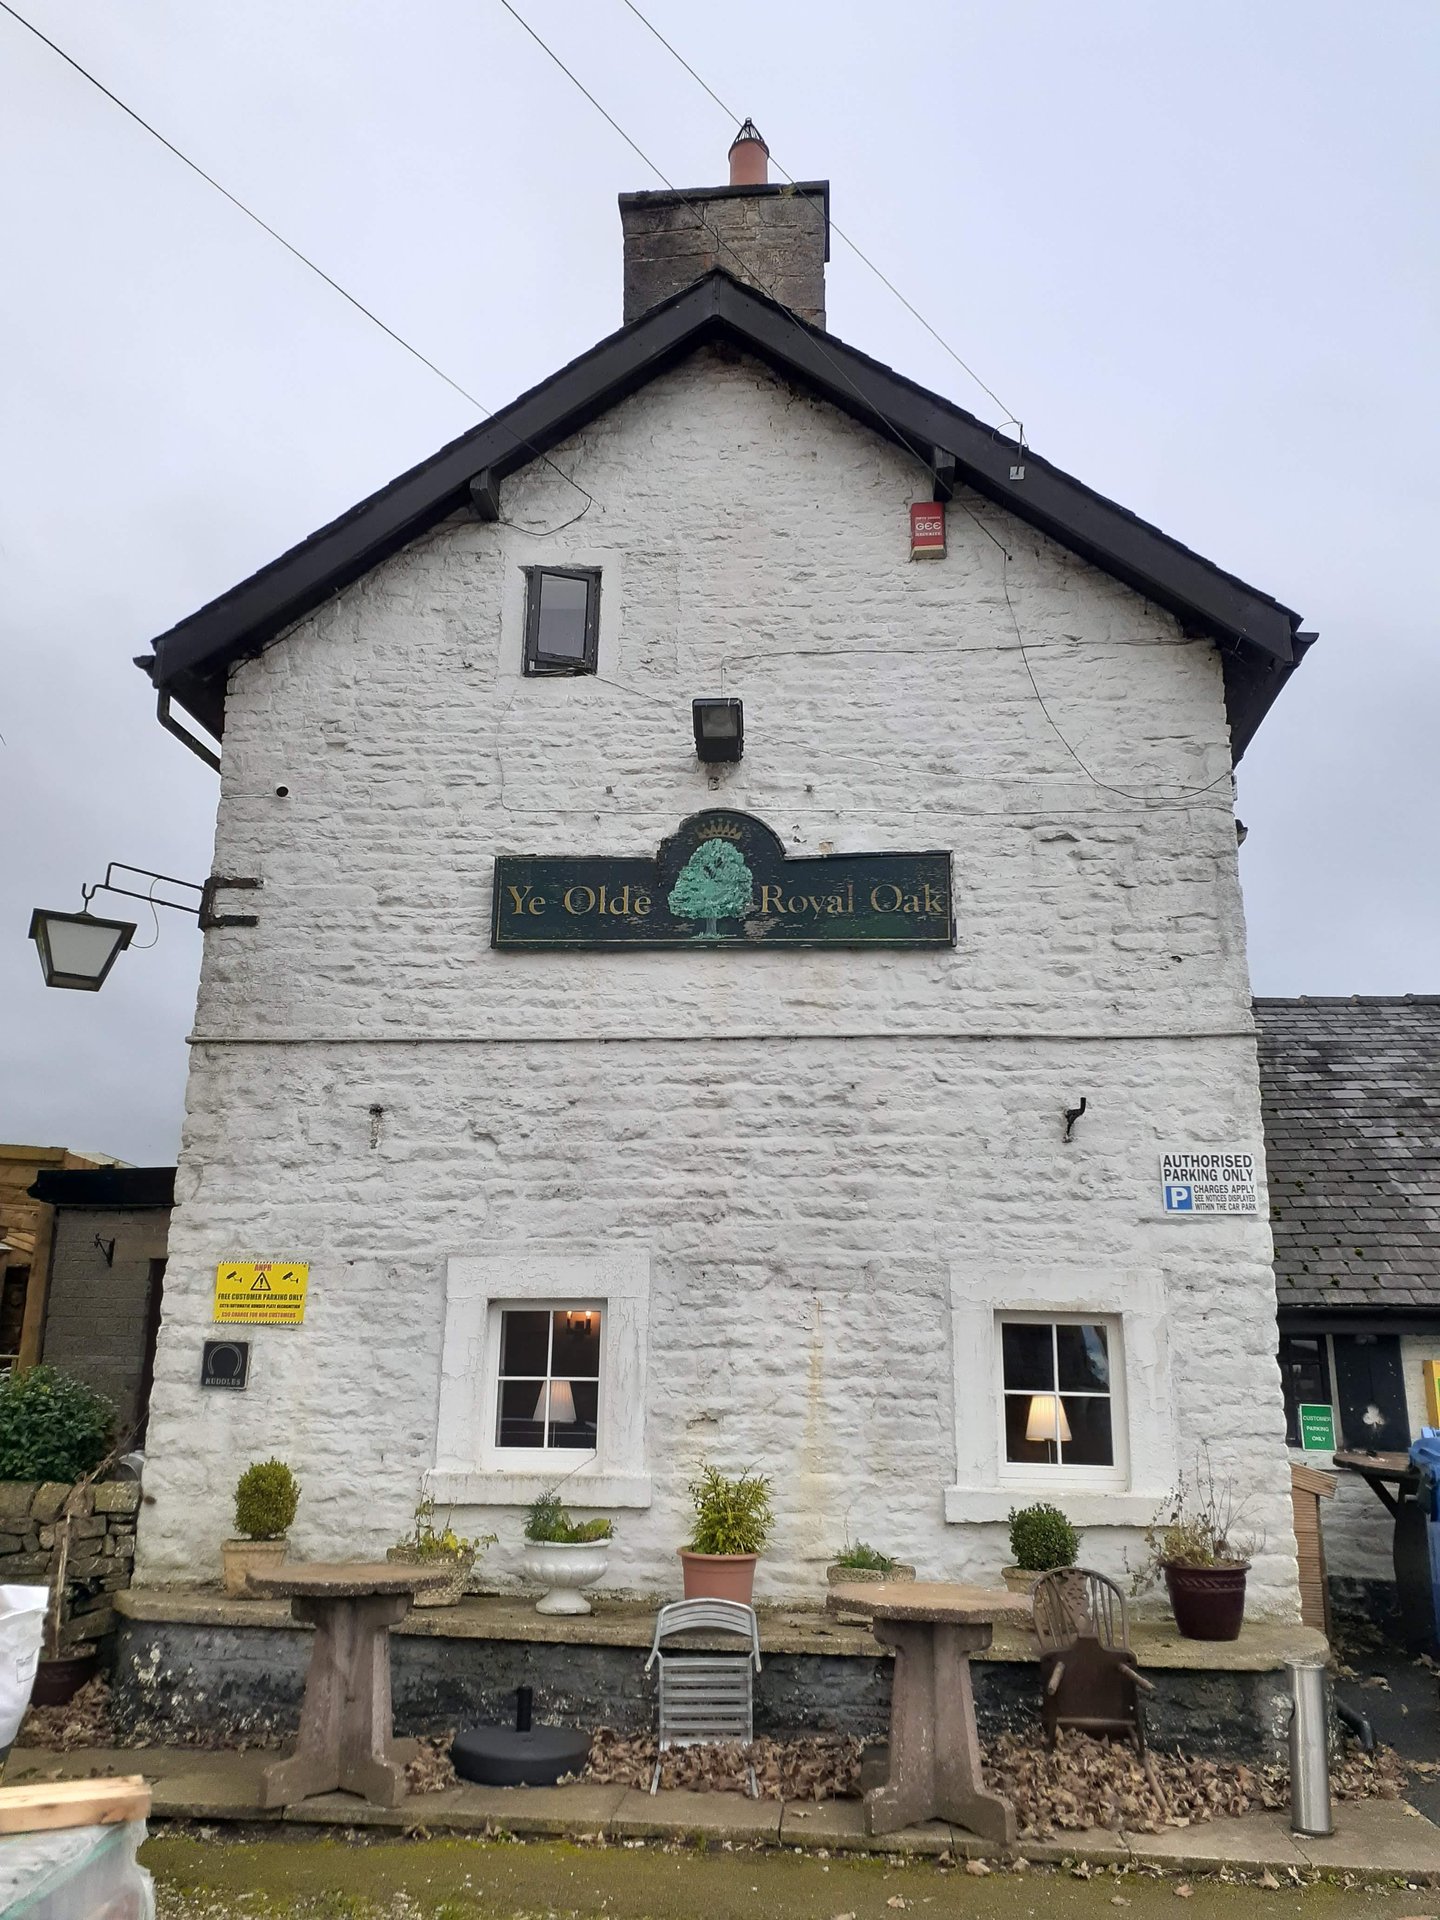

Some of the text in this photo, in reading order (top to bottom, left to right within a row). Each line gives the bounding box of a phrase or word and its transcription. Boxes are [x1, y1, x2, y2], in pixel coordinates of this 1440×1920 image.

[915, 522, 942, 530] GEE
[507, 883, 944, 920] Ye Olde Royal Oak
[1163, 1155, 1252, 1168] AUTHORISED
[1164, 1169, 1253, 1181] PARKING ONLY
[1193, 1185, 1255, 1194] CHARGES APPLY
[1170, 1187, 1189, 1208] P
[1194, 1194, 1256, 1203] SEE NOTICES DISPLAYED
[1195, 1203, 1257, 1211] WITHIN THE CAR PARK
[254, 1264, 272, 1272] ANPR
[217, 1292, 303, 1301] FREE CUSTOMER PARKING ONLY
